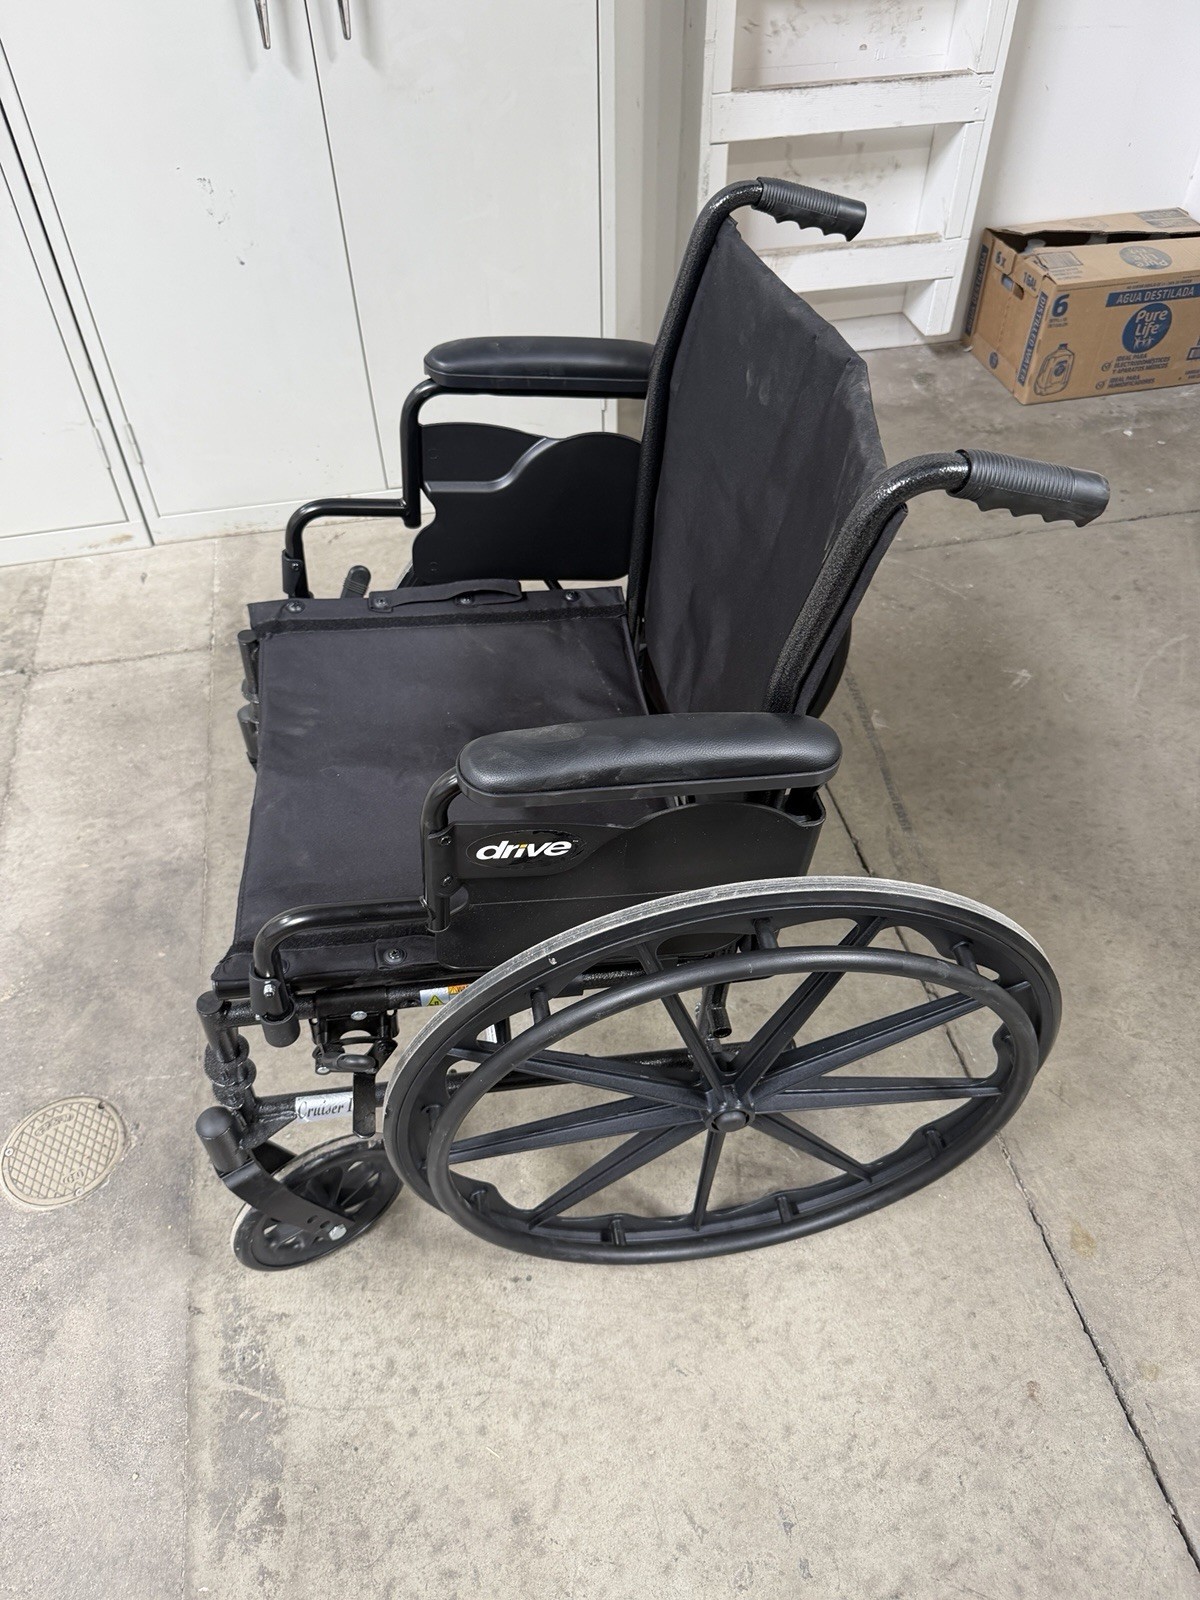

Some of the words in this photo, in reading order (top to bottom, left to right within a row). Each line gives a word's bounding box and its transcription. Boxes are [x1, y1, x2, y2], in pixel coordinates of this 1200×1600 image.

[1052, 293, 1070, 317] 6
[1116, 292, 1142, 304] AGUA
[1144, 287, 1195, 301] DESTILADA
[1027, 296, 1047, 347] DISTILLED
[1135, 310, 1168, 323] Pure
[1135, 322, 1160, 338] Life
[1018, 348, 1034, 383] WATER
[476, 841, 572, 860] drive
[298, 1100, 344, 1119] Cruiser
